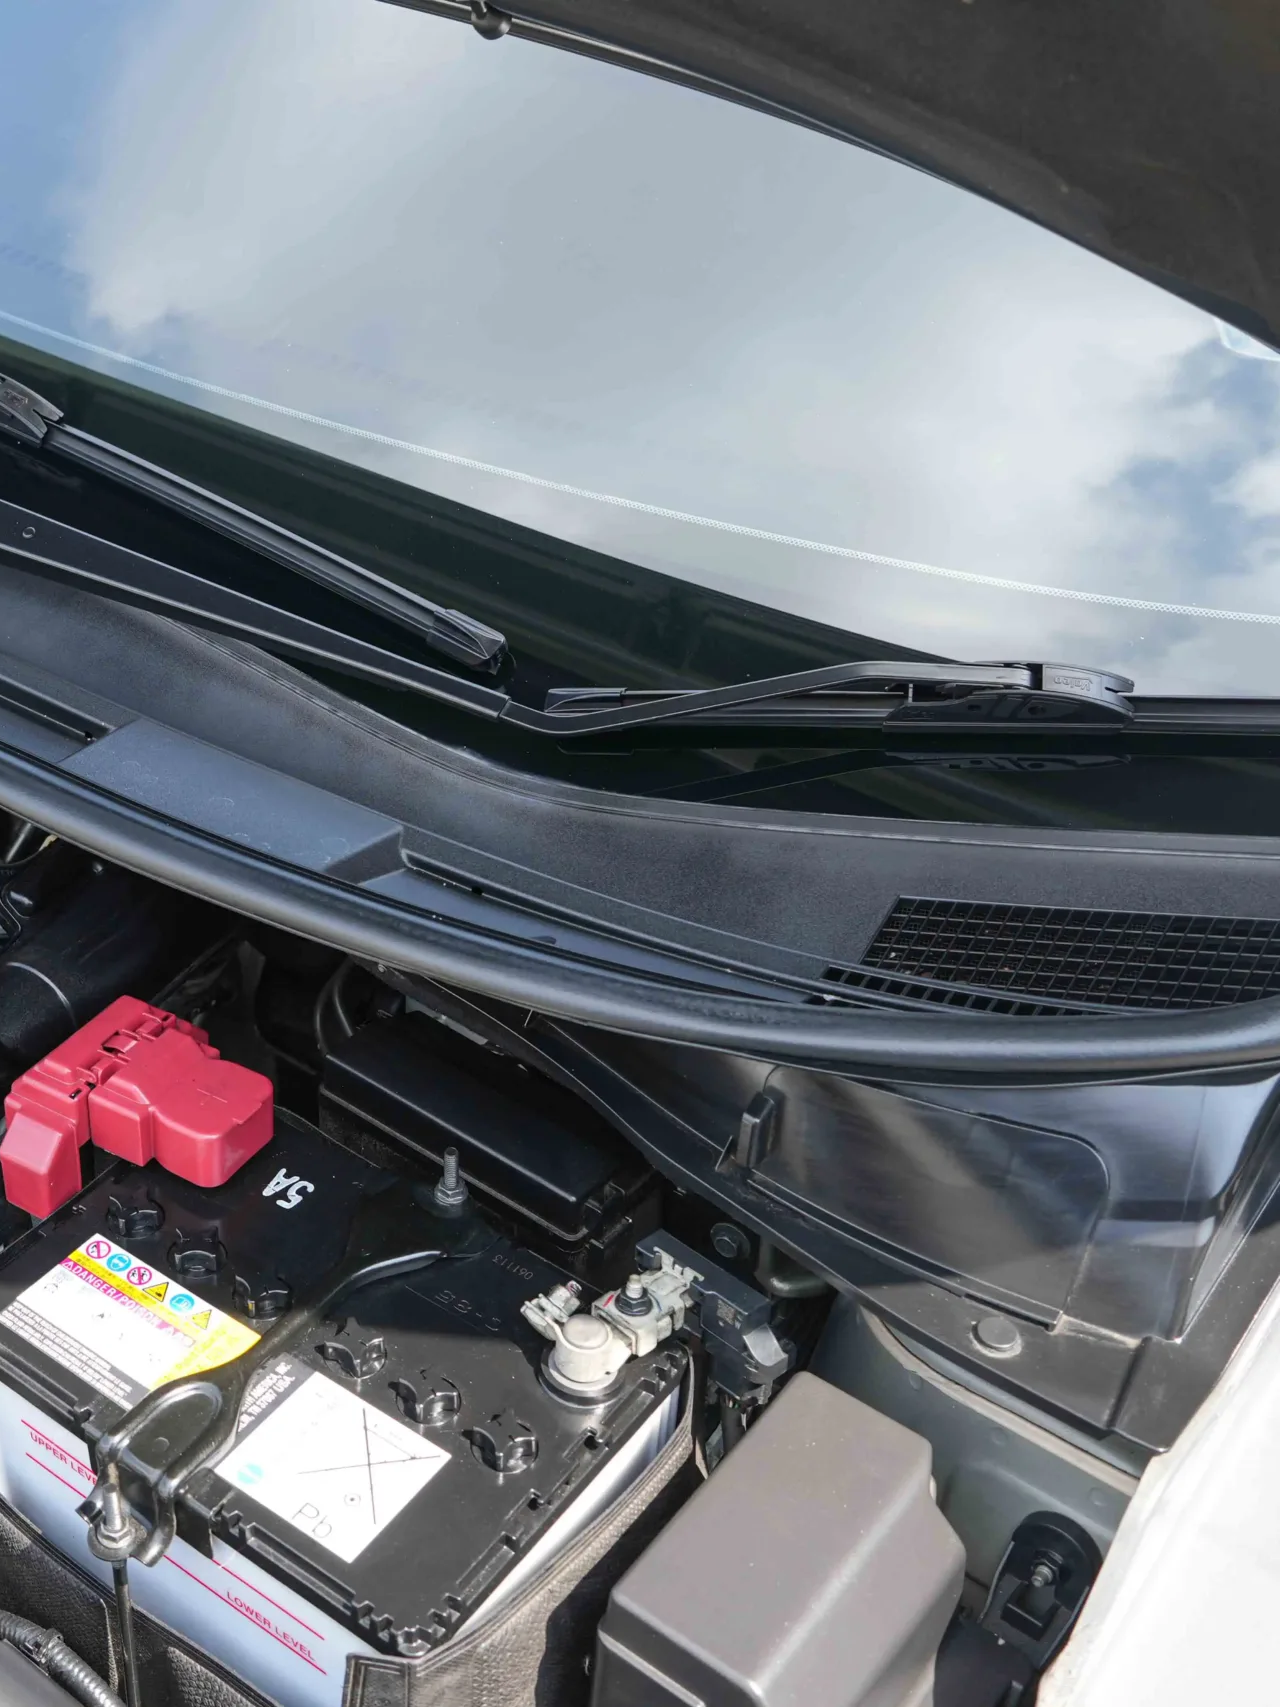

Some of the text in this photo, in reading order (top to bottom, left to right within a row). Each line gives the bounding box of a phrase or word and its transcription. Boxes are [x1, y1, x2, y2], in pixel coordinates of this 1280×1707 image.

[262, 1168, 315, 1209] 5A
[30, 1431, 98, 1486] UPPER LEVE
[291, 1502, 333, 1538] Pb
[227, 1591, 316, 1662] LOWER LEVEL
